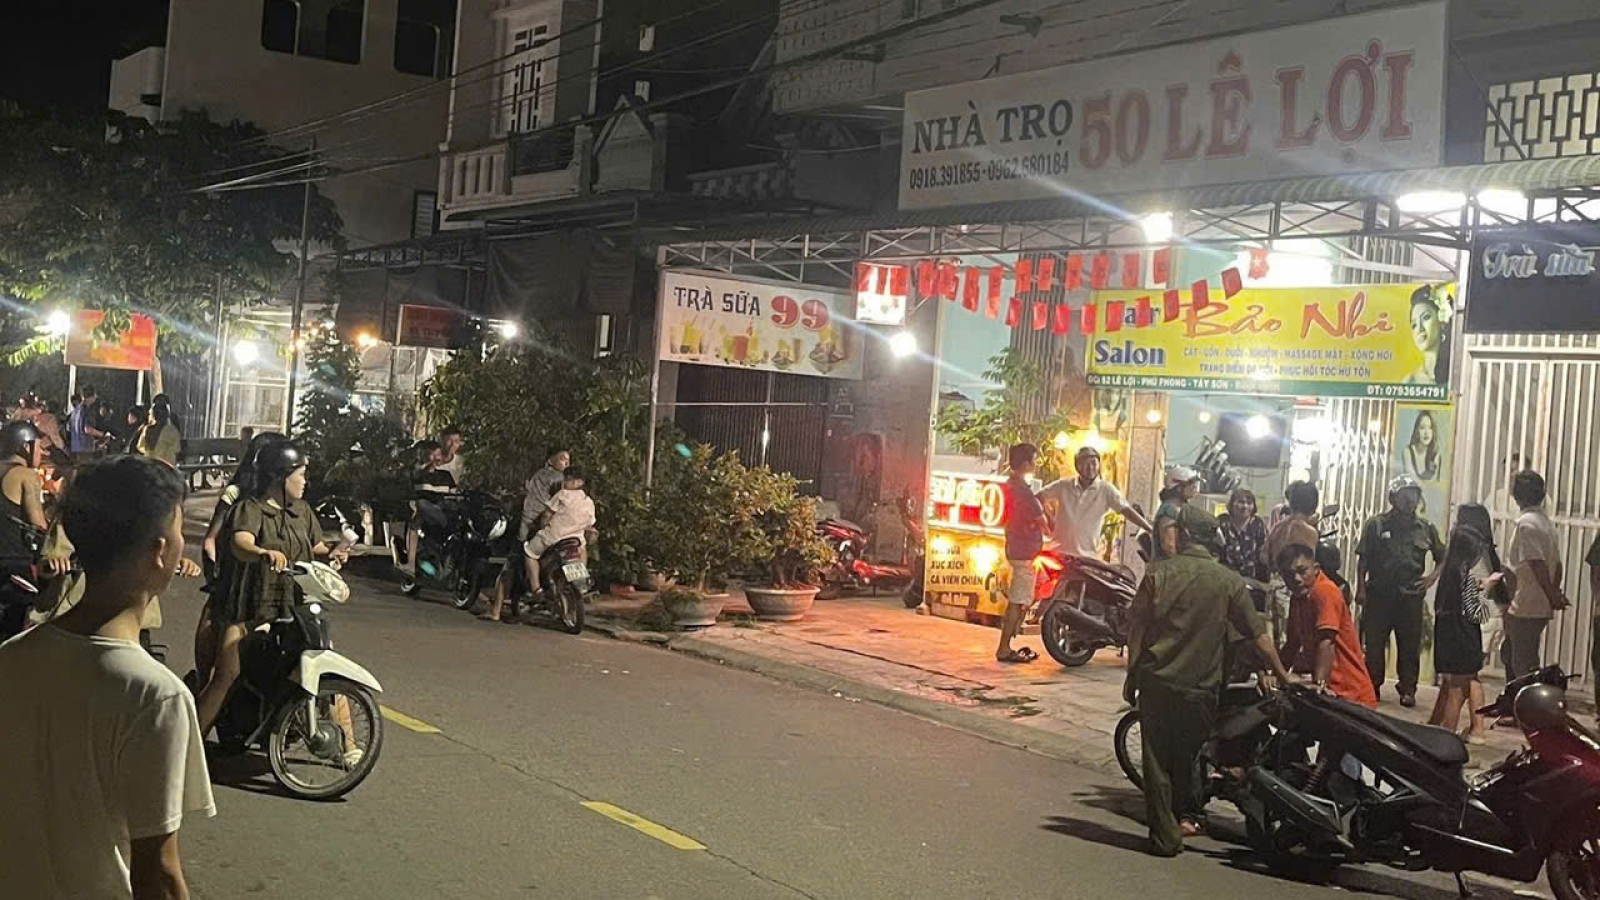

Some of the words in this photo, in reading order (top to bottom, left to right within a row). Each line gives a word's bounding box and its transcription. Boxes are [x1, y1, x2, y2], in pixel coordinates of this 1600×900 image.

[911, 100, 986, 154] NHÀ
[996, 99, 1073, 146] TRỌ
[1079, 87, 1152, 171] 50
[1163, 50, 1252, 162] LÊ
[1274, 38, 1414, 164] LỢI
[673, 286, 713, 311] TRÀ
[722, 289, 761, 316] SỮA
[770, 295, 829, 331] 99
[1104, 300, 1161, 326] ar
[1178, 299, 1281, 339] Bảo
[1300, 291, 1396, 340] Nhi
[1094, 340, 1166, 366] Salon
